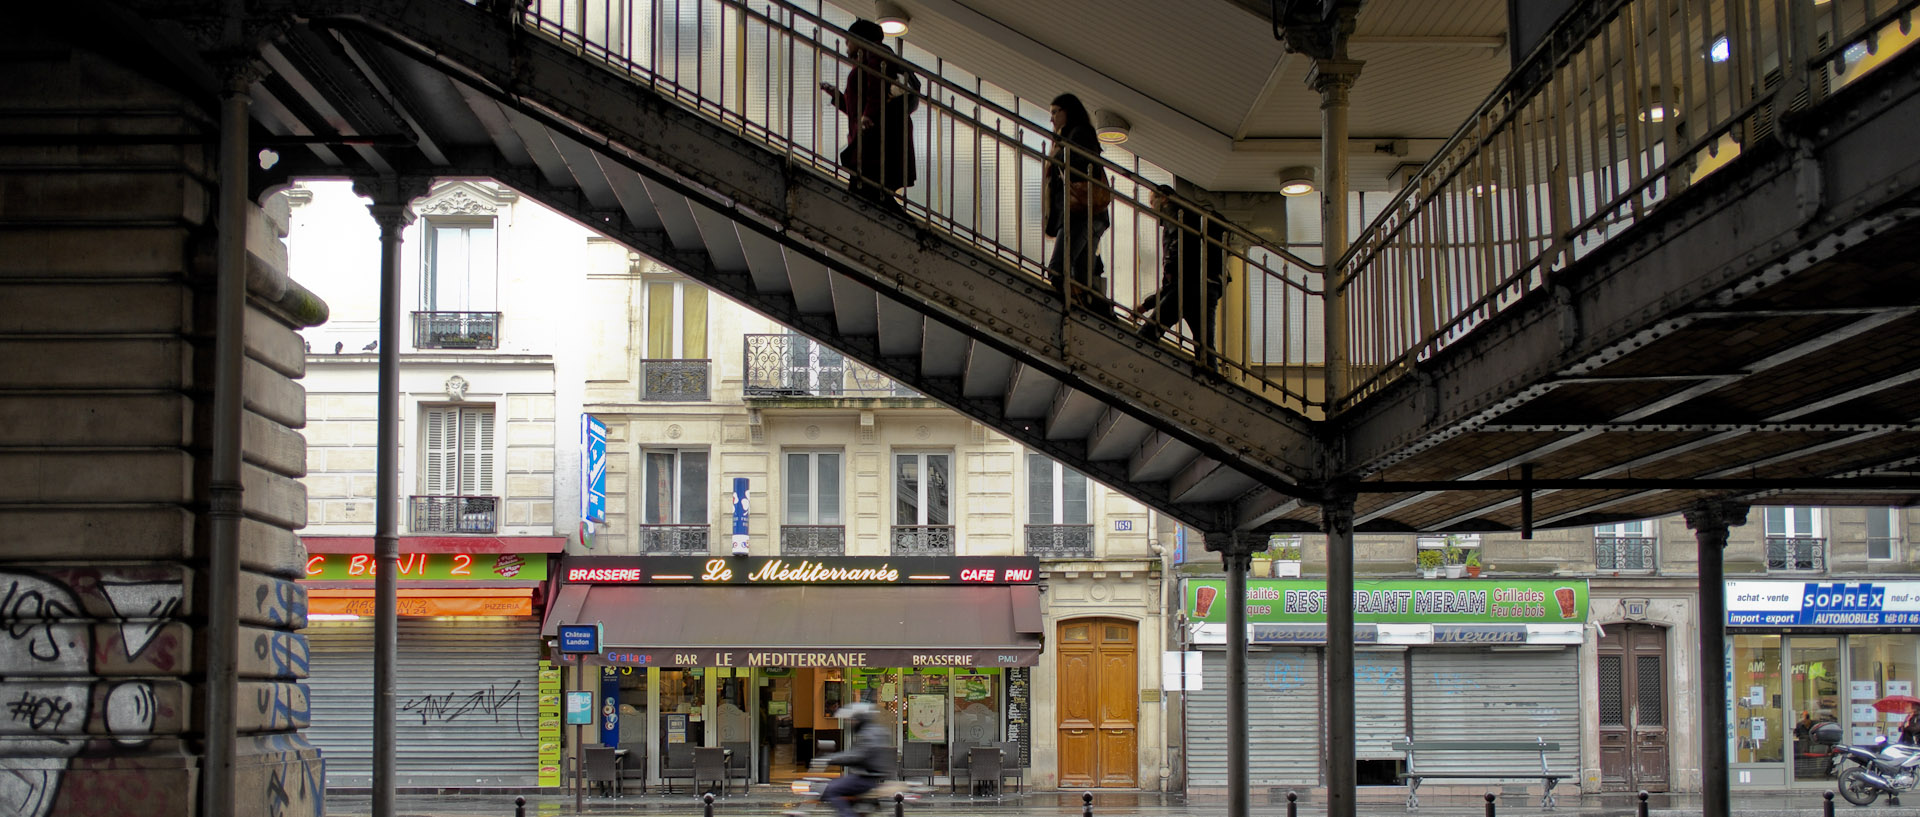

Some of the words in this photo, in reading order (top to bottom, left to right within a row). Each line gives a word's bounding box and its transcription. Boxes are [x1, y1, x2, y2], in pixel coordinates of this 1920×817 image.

[1115, 520, 1131, 530] 169
[450, 554, 473, 576] 2
[568, 568, 641, 582] BRASSERIE
[702, 559, 733, 582] Le
[748, 559, 899, 582] Méditerranée
[1004, 568, 1033, 582] PMU
[1246, 587, 1279, 600] cialités
[1285, 590, 1411, 613] RESTRANT
[1415, 590, 1486, 613] MERAM
[1493, 588, 1544, 602] Grillades
[1737, 594, 1760, 602] achat
[1766, 594, 1789, 602] vente
[1803, 593, 1884, 607] SOPREX
[1890, 593, 1909, 602] neuf
[1247, 605, 1271, 617] ques
[1491, 604, 1509, 617] Feu
[1511, 604, 1522, 617] de
[1524, 604, 1545, 617] bois
[1730, 613, 1760, 624] import
[1765, 613, 1794, 624] export
[1815, 613, 1879, 624] AUTOMOBILES
[1897, 613, 1908, 624] 01
[1908, 613, 1919, 624] 46
[564, 630, 591, 638] Château
[1435, 627, 1521, 642] Meram
[675, 654, 698, 665] BAR
[715, 653, 733, 666] LE
[748, 653, 867, 667] MEDITERRANEE
[912, 654, 973, 666] BRASSERIE
[998, 655, 1018, 663] PMU
